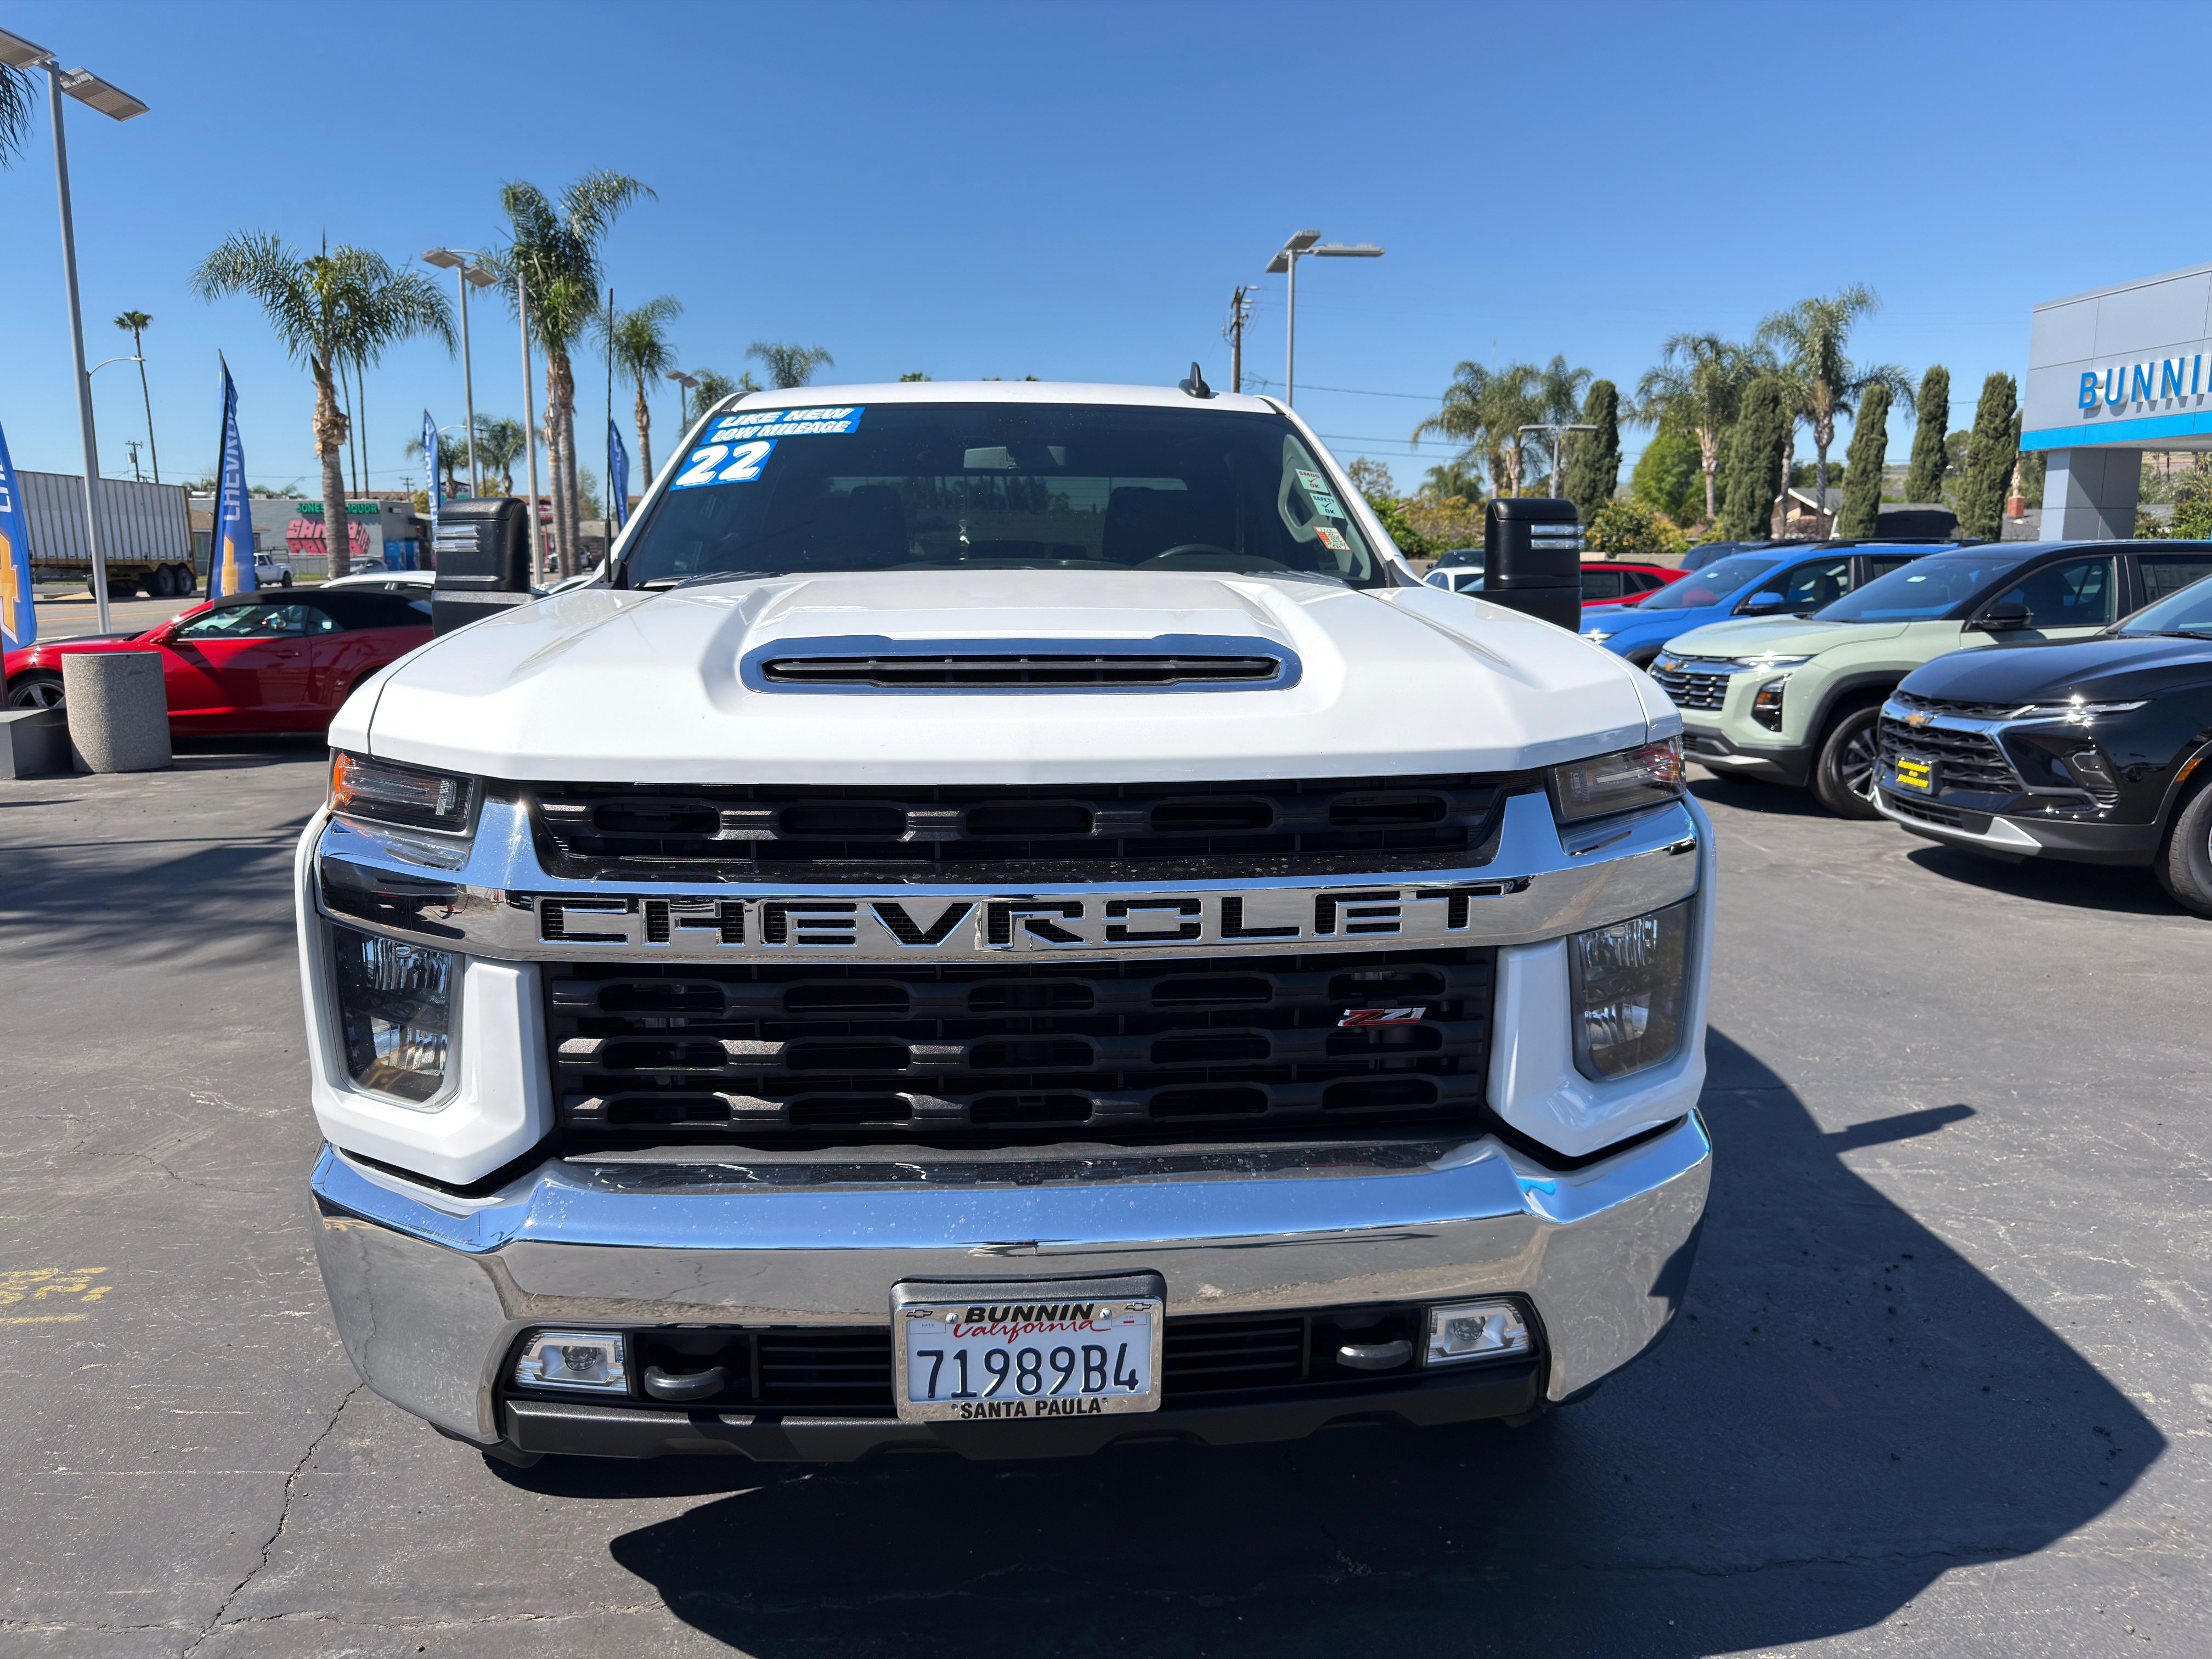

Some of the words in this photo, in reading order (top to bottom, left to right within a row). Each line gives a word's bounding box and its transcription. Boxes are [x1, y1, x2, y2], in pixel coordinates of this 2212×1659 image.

[2078, 354, 2212, 409] BUNNI
[717, 411, 783, 428] LIKE
[783, 408, 855, 422] NEW
[710, 425, 761, 443] LOW
[757, 421, 851, 437] MILEAGE
[675, 441, 771, 487] 22
[346, 504, 380, 514] IQUOR
[1313, 495, 1335, 504] SAFETY
[285, 520, 360, 539] SANA
[534, 884, 1504, 949] CHEVROLET
[1338, 1008, 1426, 1026] Z71
[964, 1304, 1094, 1323] BUNNIN
[953, 1319, 1111, 1344] California
[916, 1342, 1139, 1399] 71989B4
[960, 1401, 1028, 1419] SANTA
[1035, 1398, 1101, 1415] PAULA
